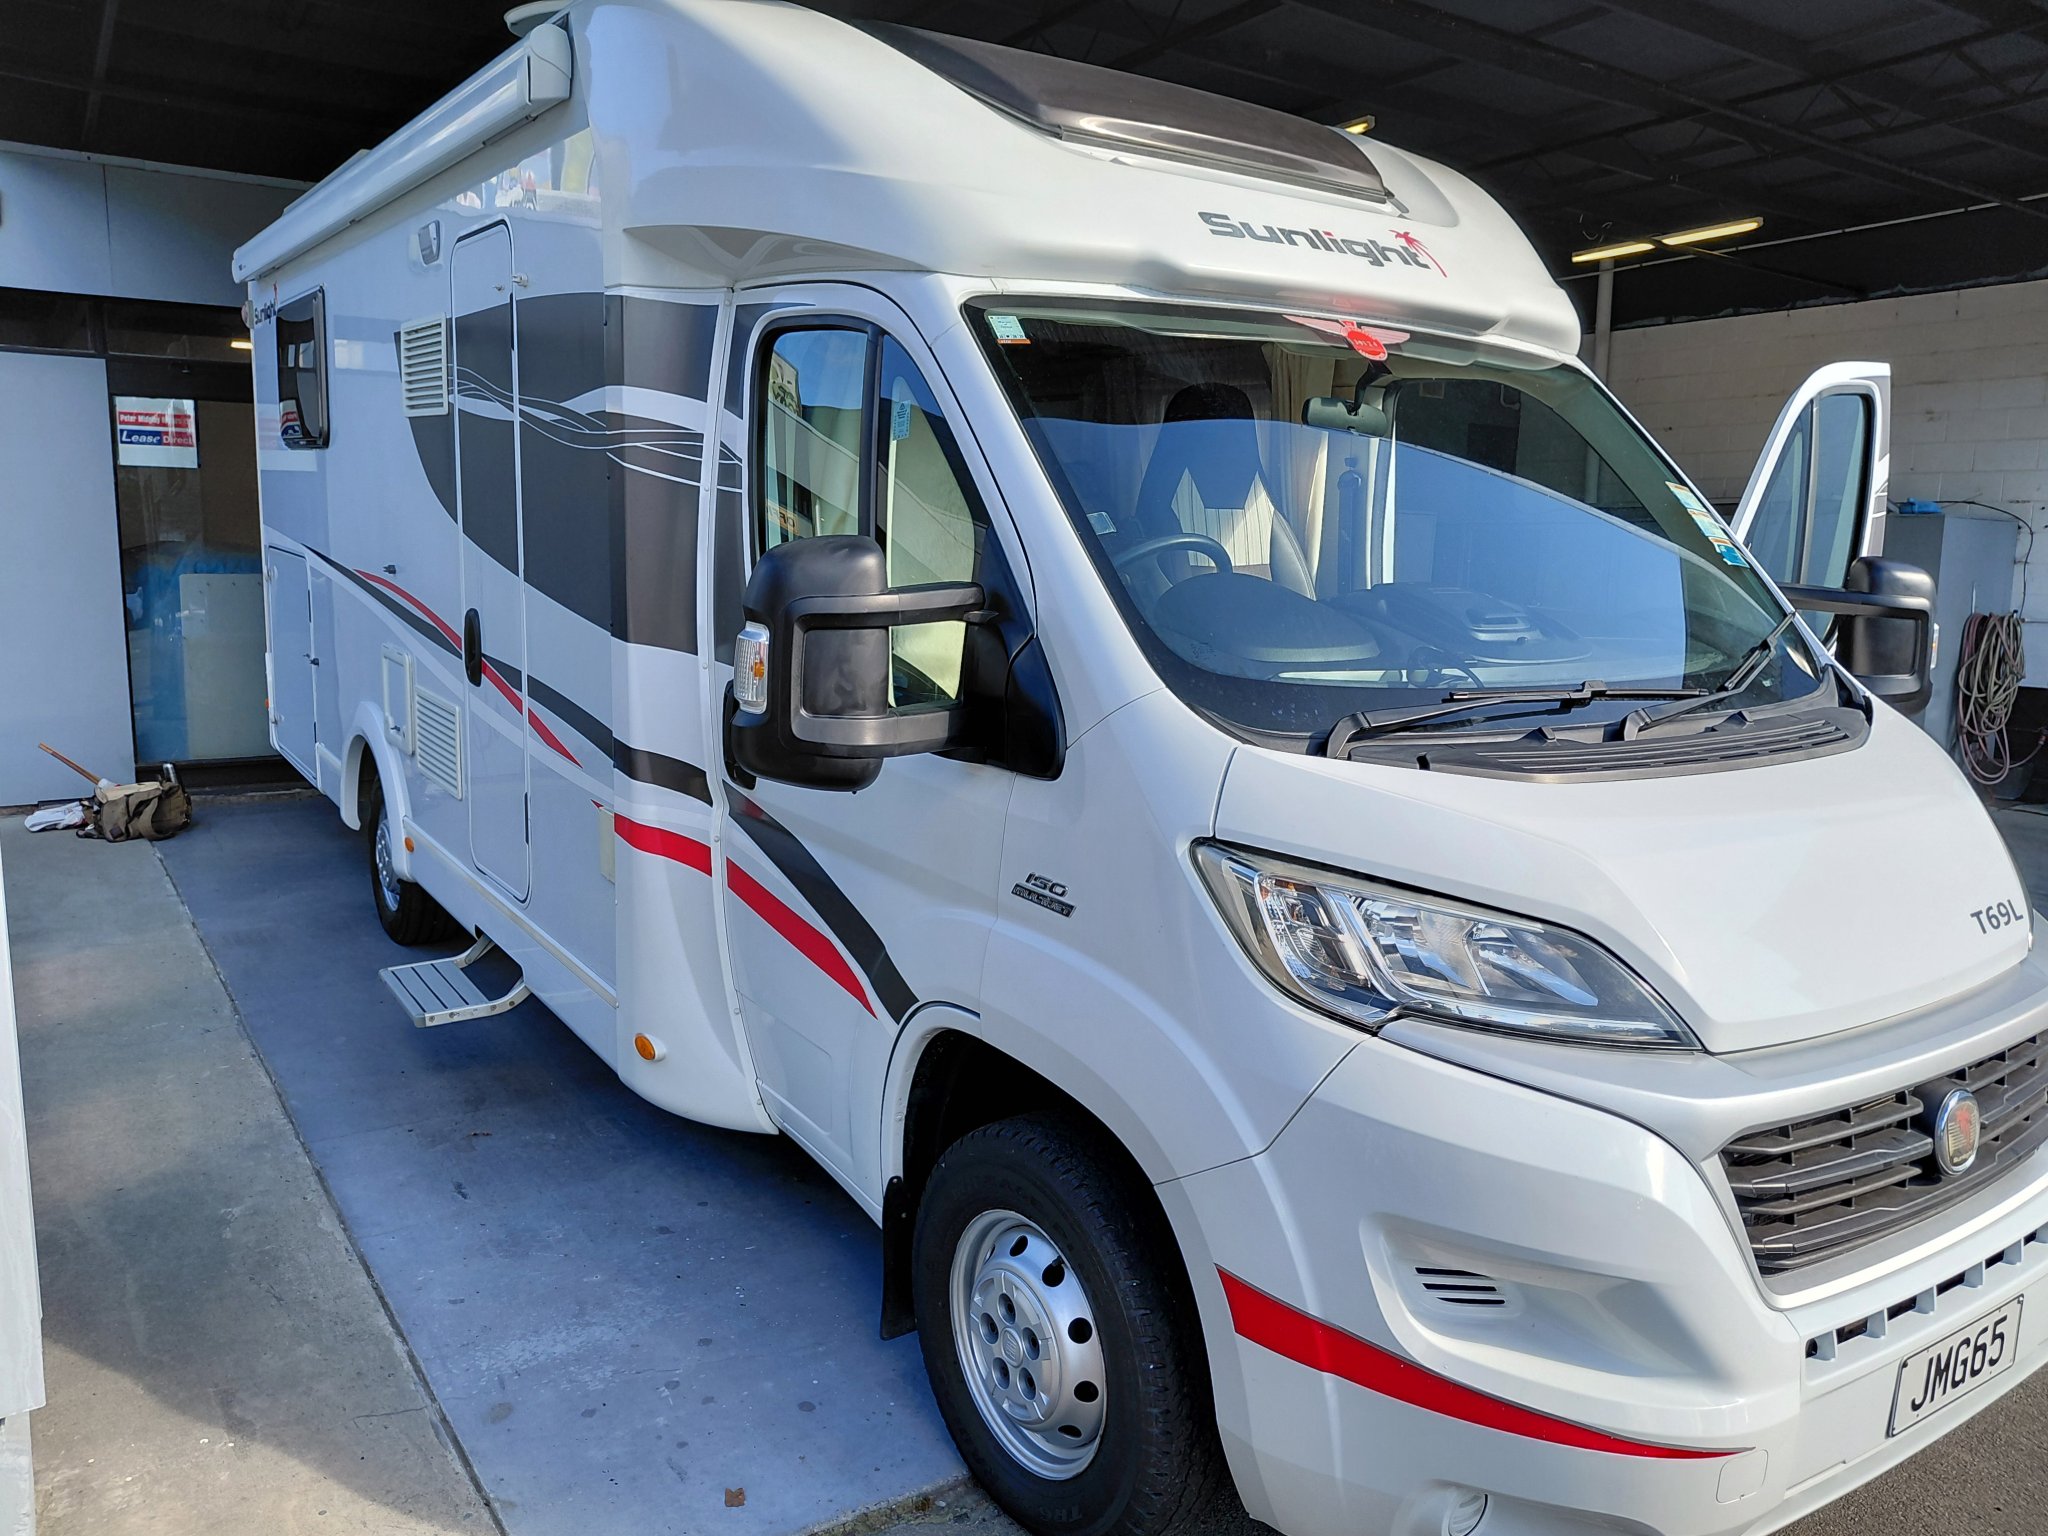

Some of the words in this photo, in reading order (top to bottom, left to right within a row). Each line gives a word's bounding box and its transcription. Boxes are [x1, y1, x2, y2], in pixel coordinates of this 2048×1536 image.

[1198, 211, 1432, 270] Sunlight
[121, 430, 161, 444] Lease
[1969, 899, 2024, 935] T69L
[1911, 1314, 2008, 1412] JMG65
